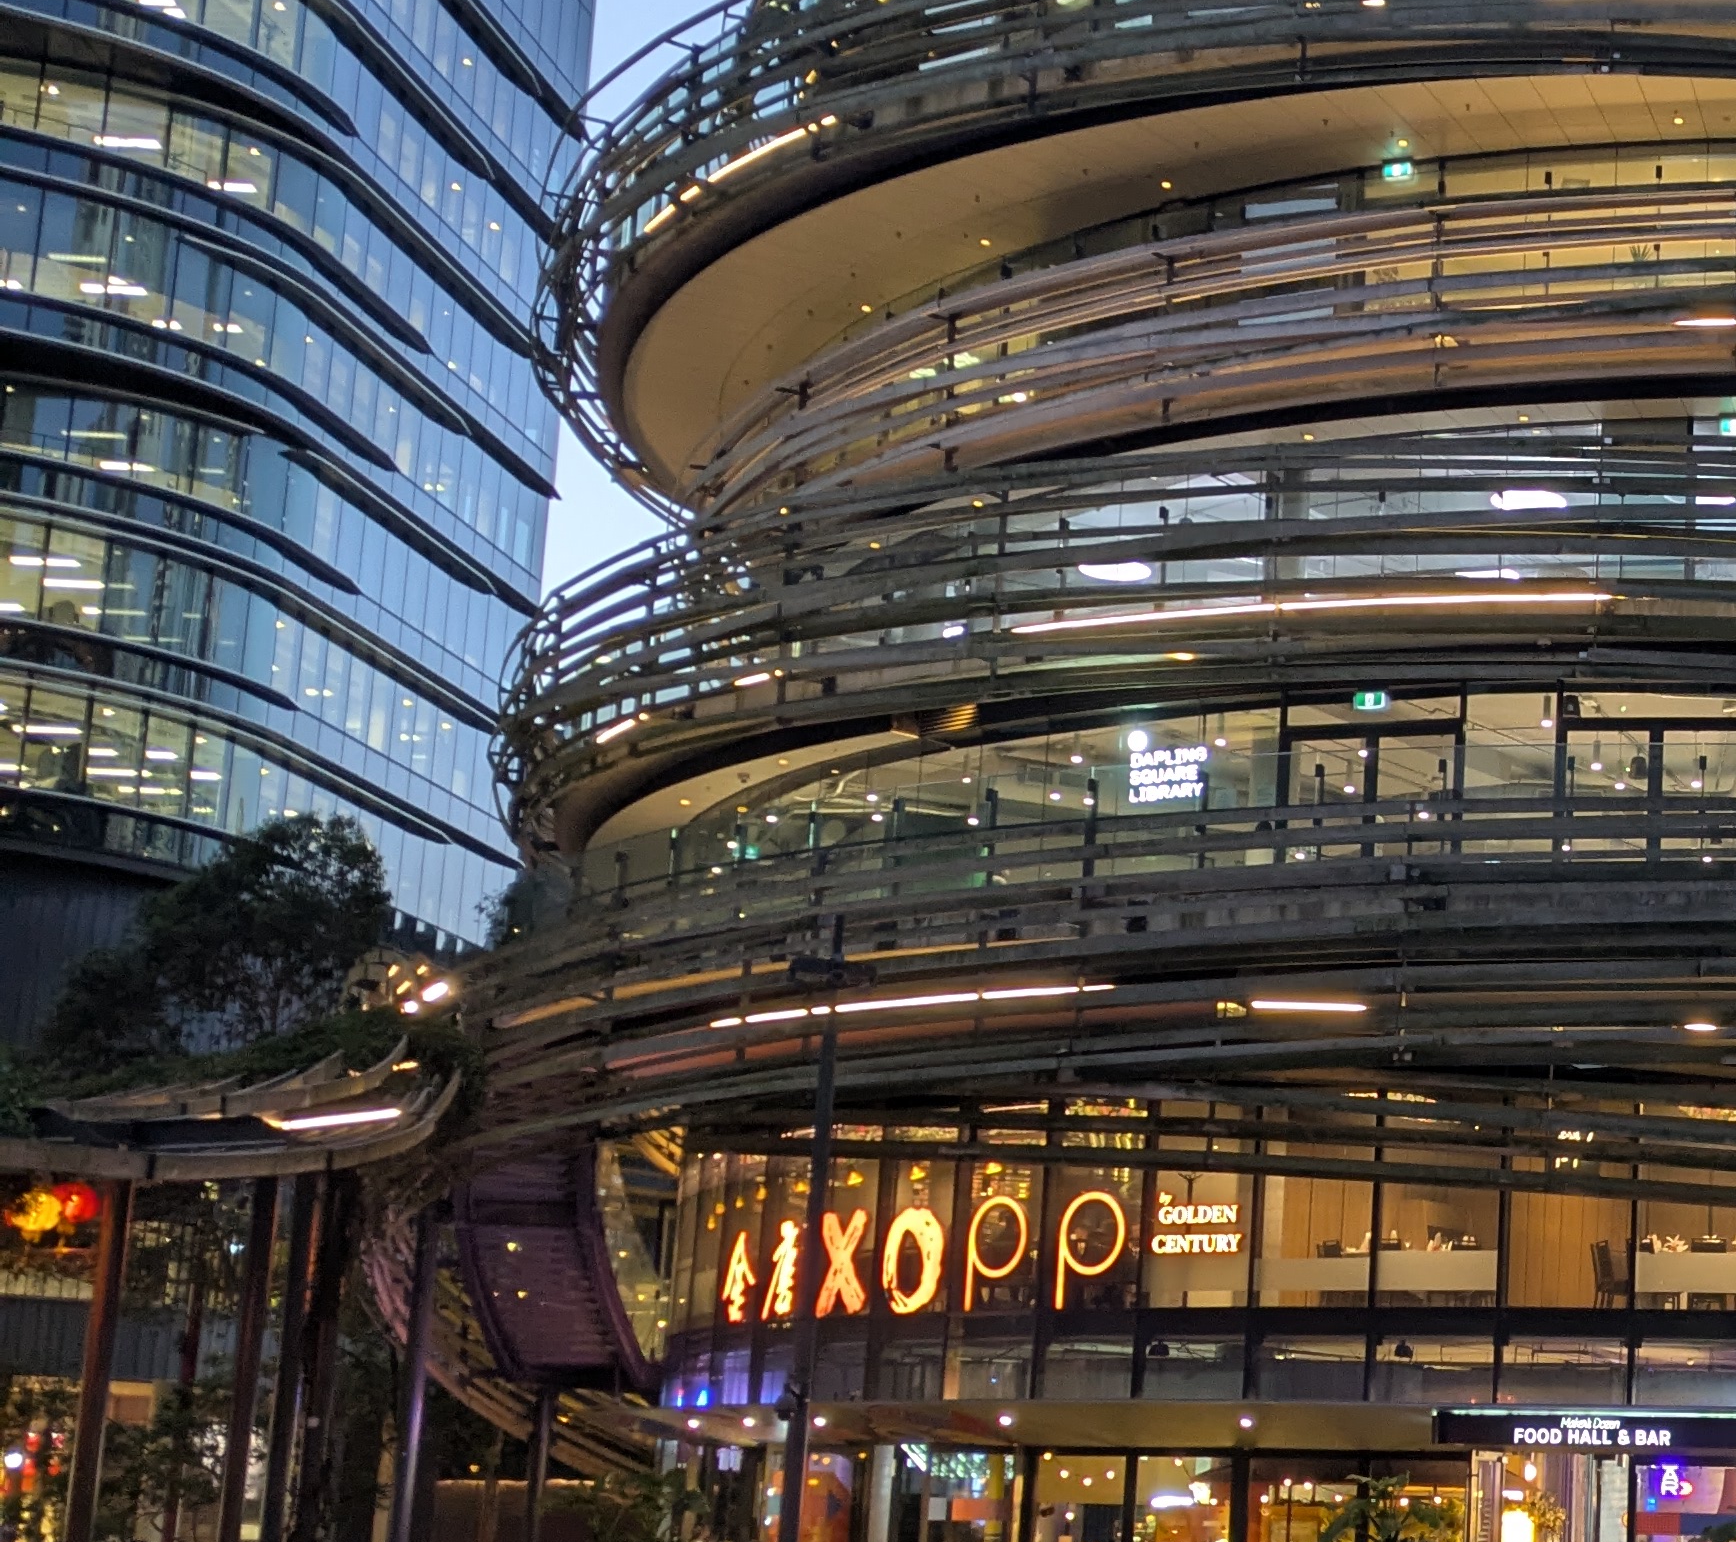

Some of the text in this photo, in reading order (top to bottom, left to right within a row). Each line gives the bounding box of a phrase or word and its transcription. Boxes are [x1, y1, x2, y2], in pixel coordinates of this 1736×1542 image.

[1129, 764, 1199, 786] SQUARE
[1128, 782, 1204, 804] LIBRARY
[1158, 1204, 1239, 1225] GOLDEN
[1151, 1233, 1242, 1254] CENTURY
[1594, 1417, 1620, 1429] Dozen
[1513, 1428, 1671, 1446] FOOD HALL & BAR
